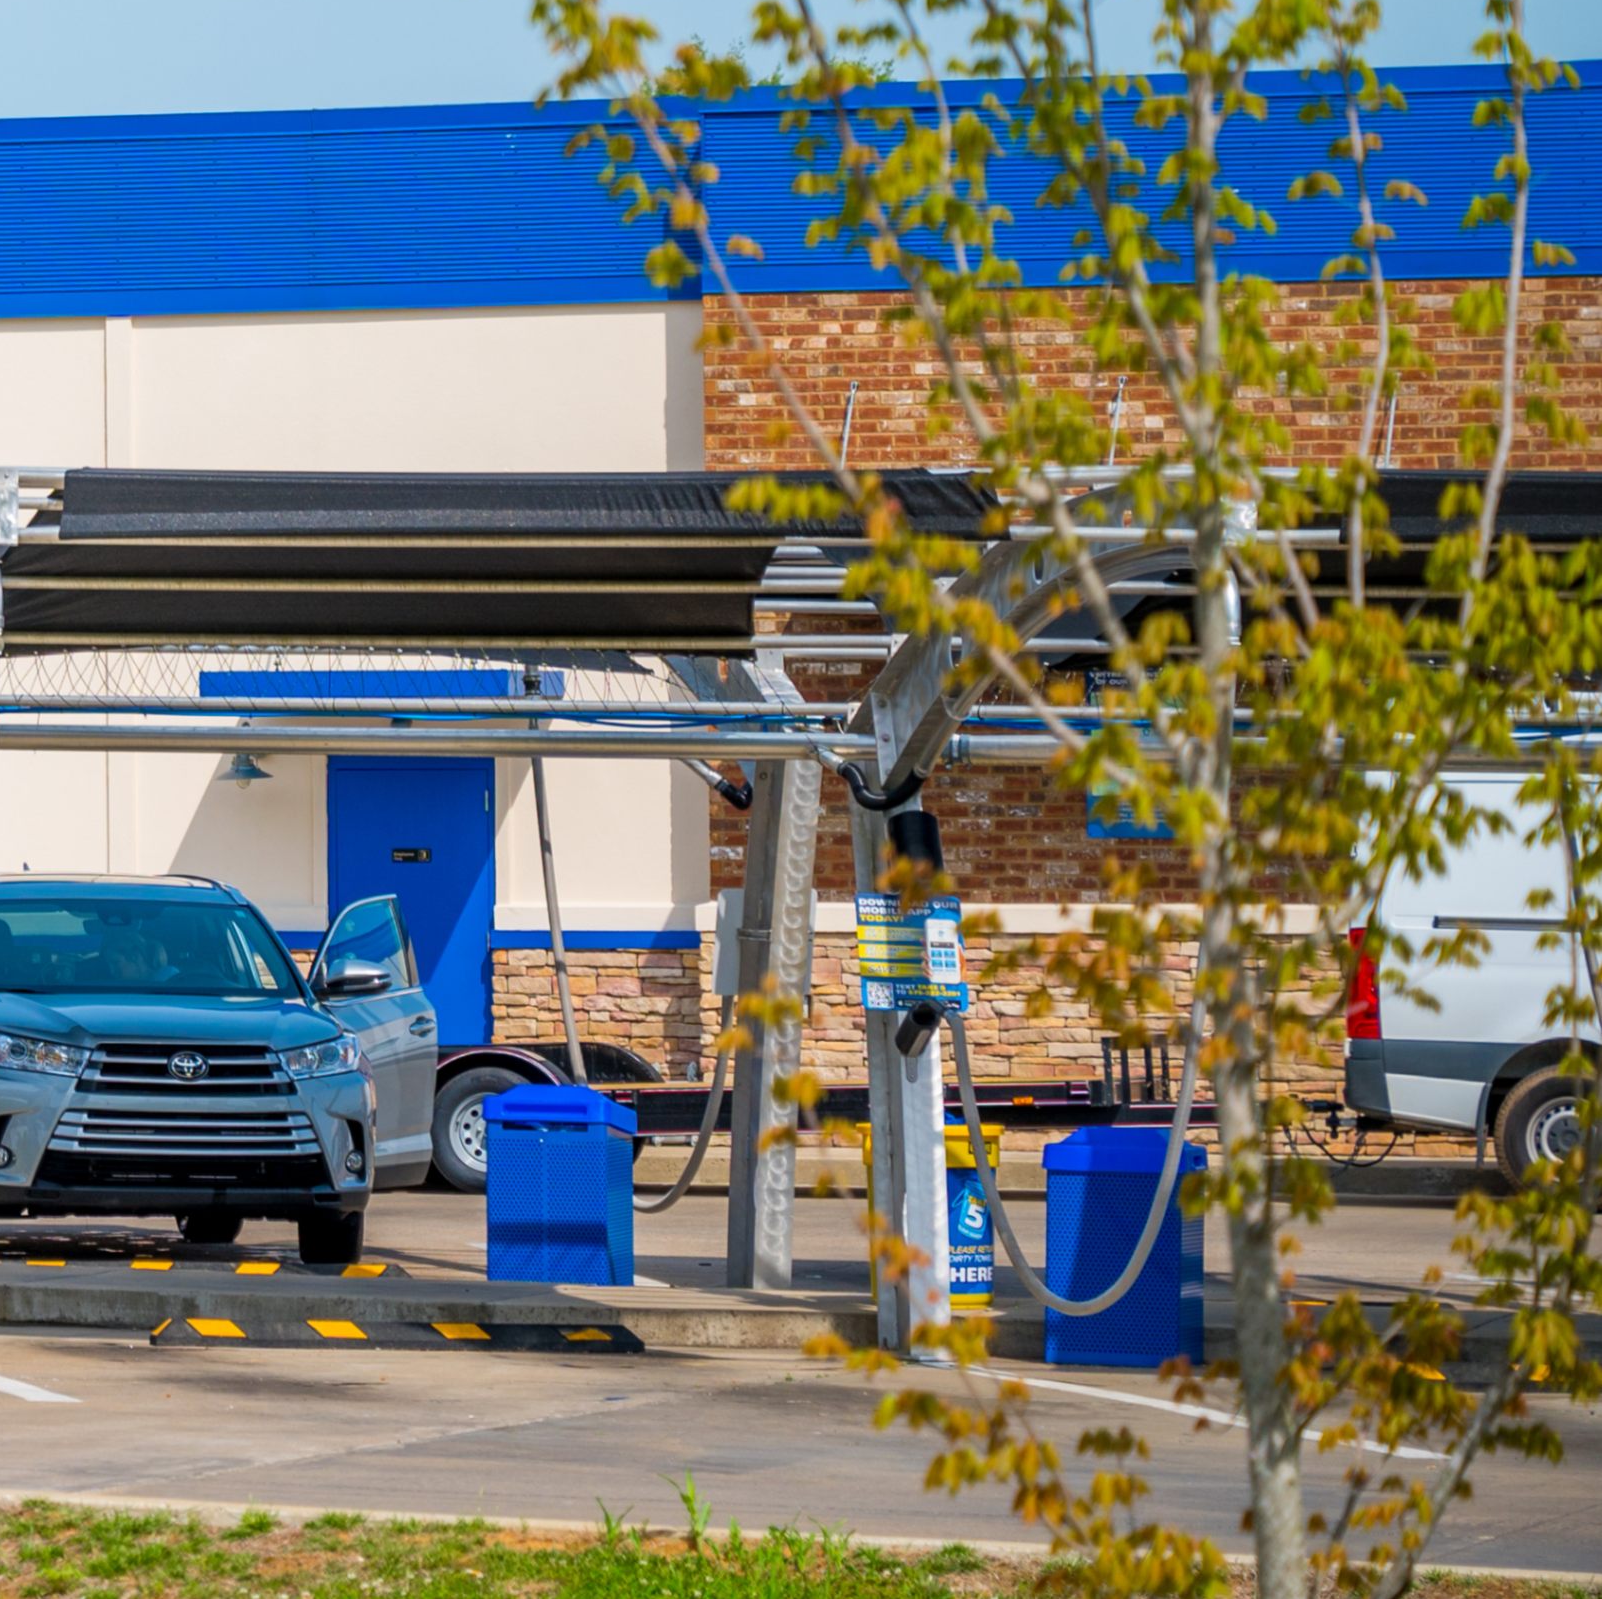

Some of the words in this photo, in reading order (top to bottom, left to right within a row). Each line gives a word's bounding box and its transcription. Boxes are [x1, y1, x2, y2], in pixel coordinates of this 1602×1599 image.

[859, 898, 929, 907] DOWNAD
[933, 901, 958, 909] OUR
[964, 1204, 985, 1229] 5
[950, 1266, 993, 1282] HERE
